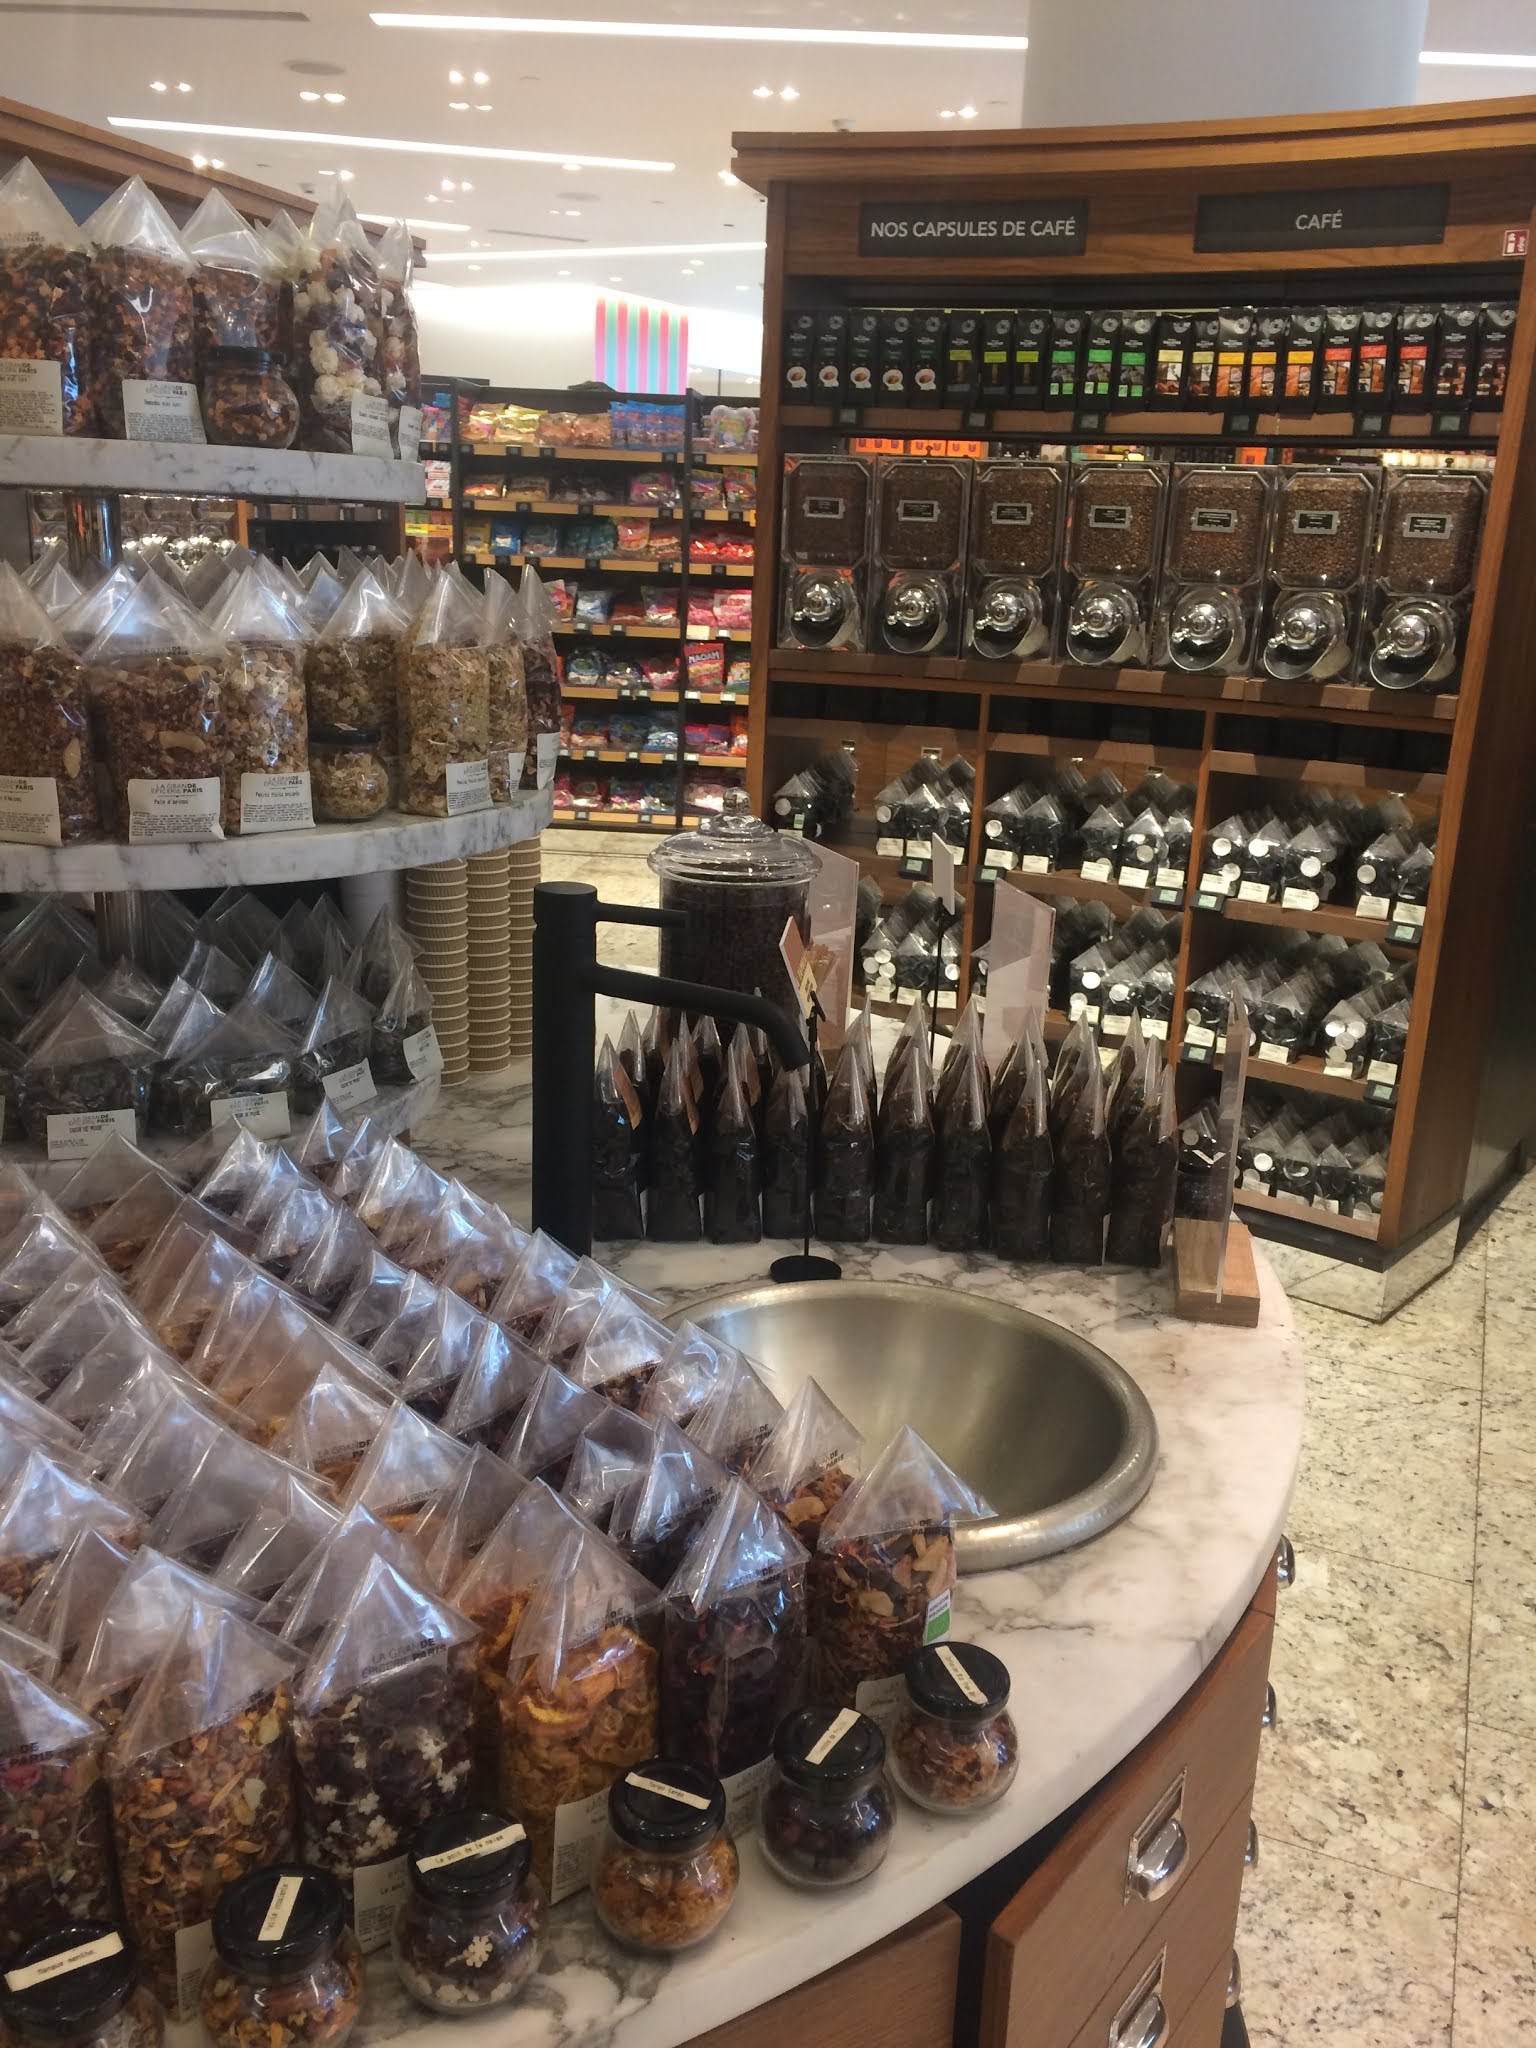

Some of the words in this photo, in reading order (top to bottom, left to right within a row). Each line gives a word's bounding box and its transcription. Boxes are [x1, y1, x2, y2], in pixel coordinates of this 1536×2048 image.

[870, 221, 908, 238] NOS
[912, 220, 998, 238] CAPSULES
[1002, 220, 1026, 238] DE
[1030, 216, 1077, 237] CAFÉ
[1295, 208, 1344, 231] CAFÉ
[688, 651, 720, 663] MAOAM
[372, 1654, 386, 1664] LA
[388, 1637, 436, 1659] GRANDE
